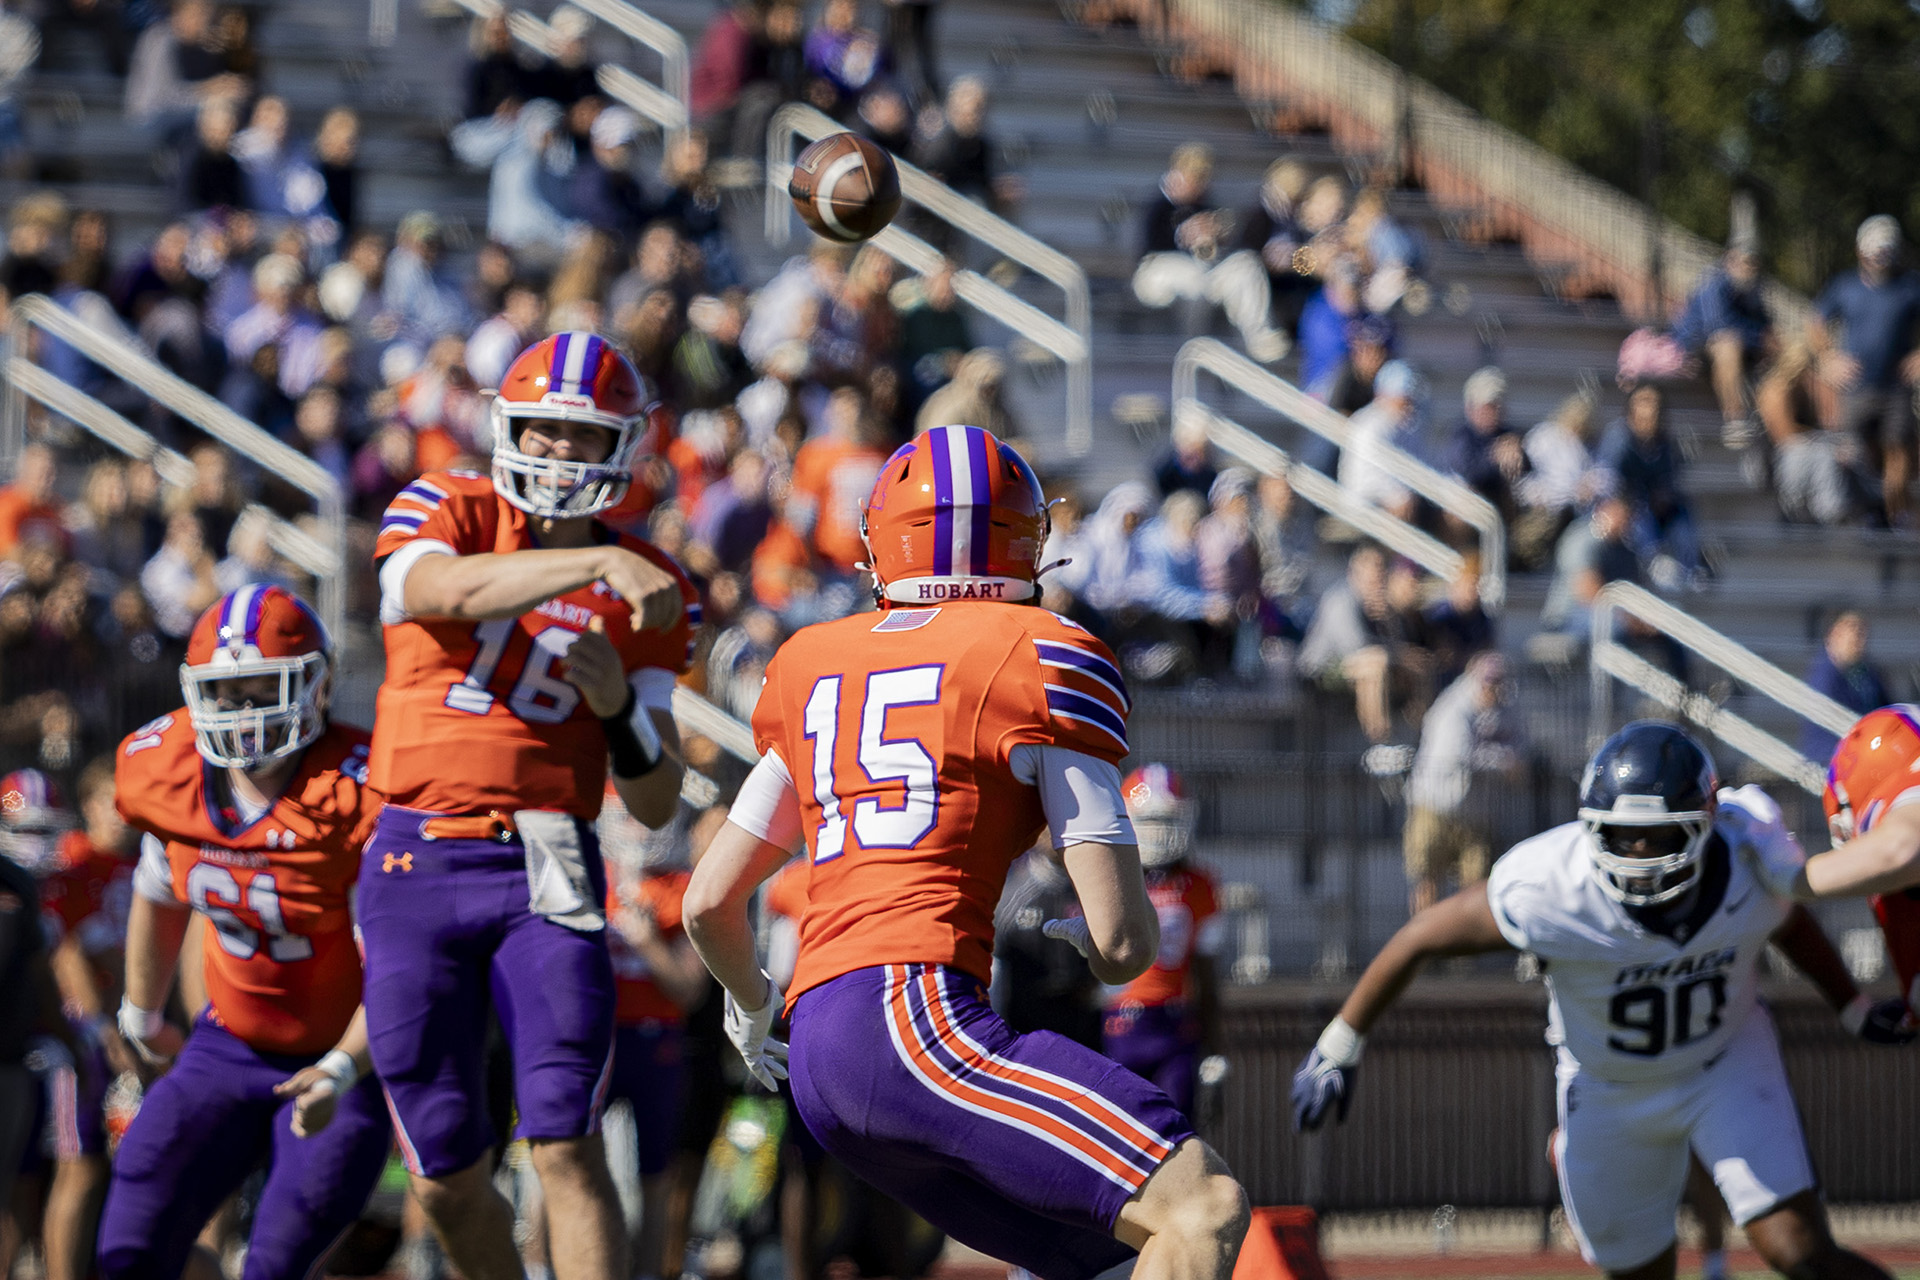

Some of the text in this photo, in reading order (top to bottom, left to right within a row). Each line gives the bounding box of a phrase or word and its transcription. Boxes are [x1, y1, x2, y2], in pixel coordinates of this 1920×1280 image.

[534, 598, 594, 627] BART
[918, 582, 1006, 599] HOBART
[445, 615, 581, 725] 16
[803, 663, 947, 867] 15
[187, 861, 314, 963] 61
[1607, 974, 1727, 1057] 90
